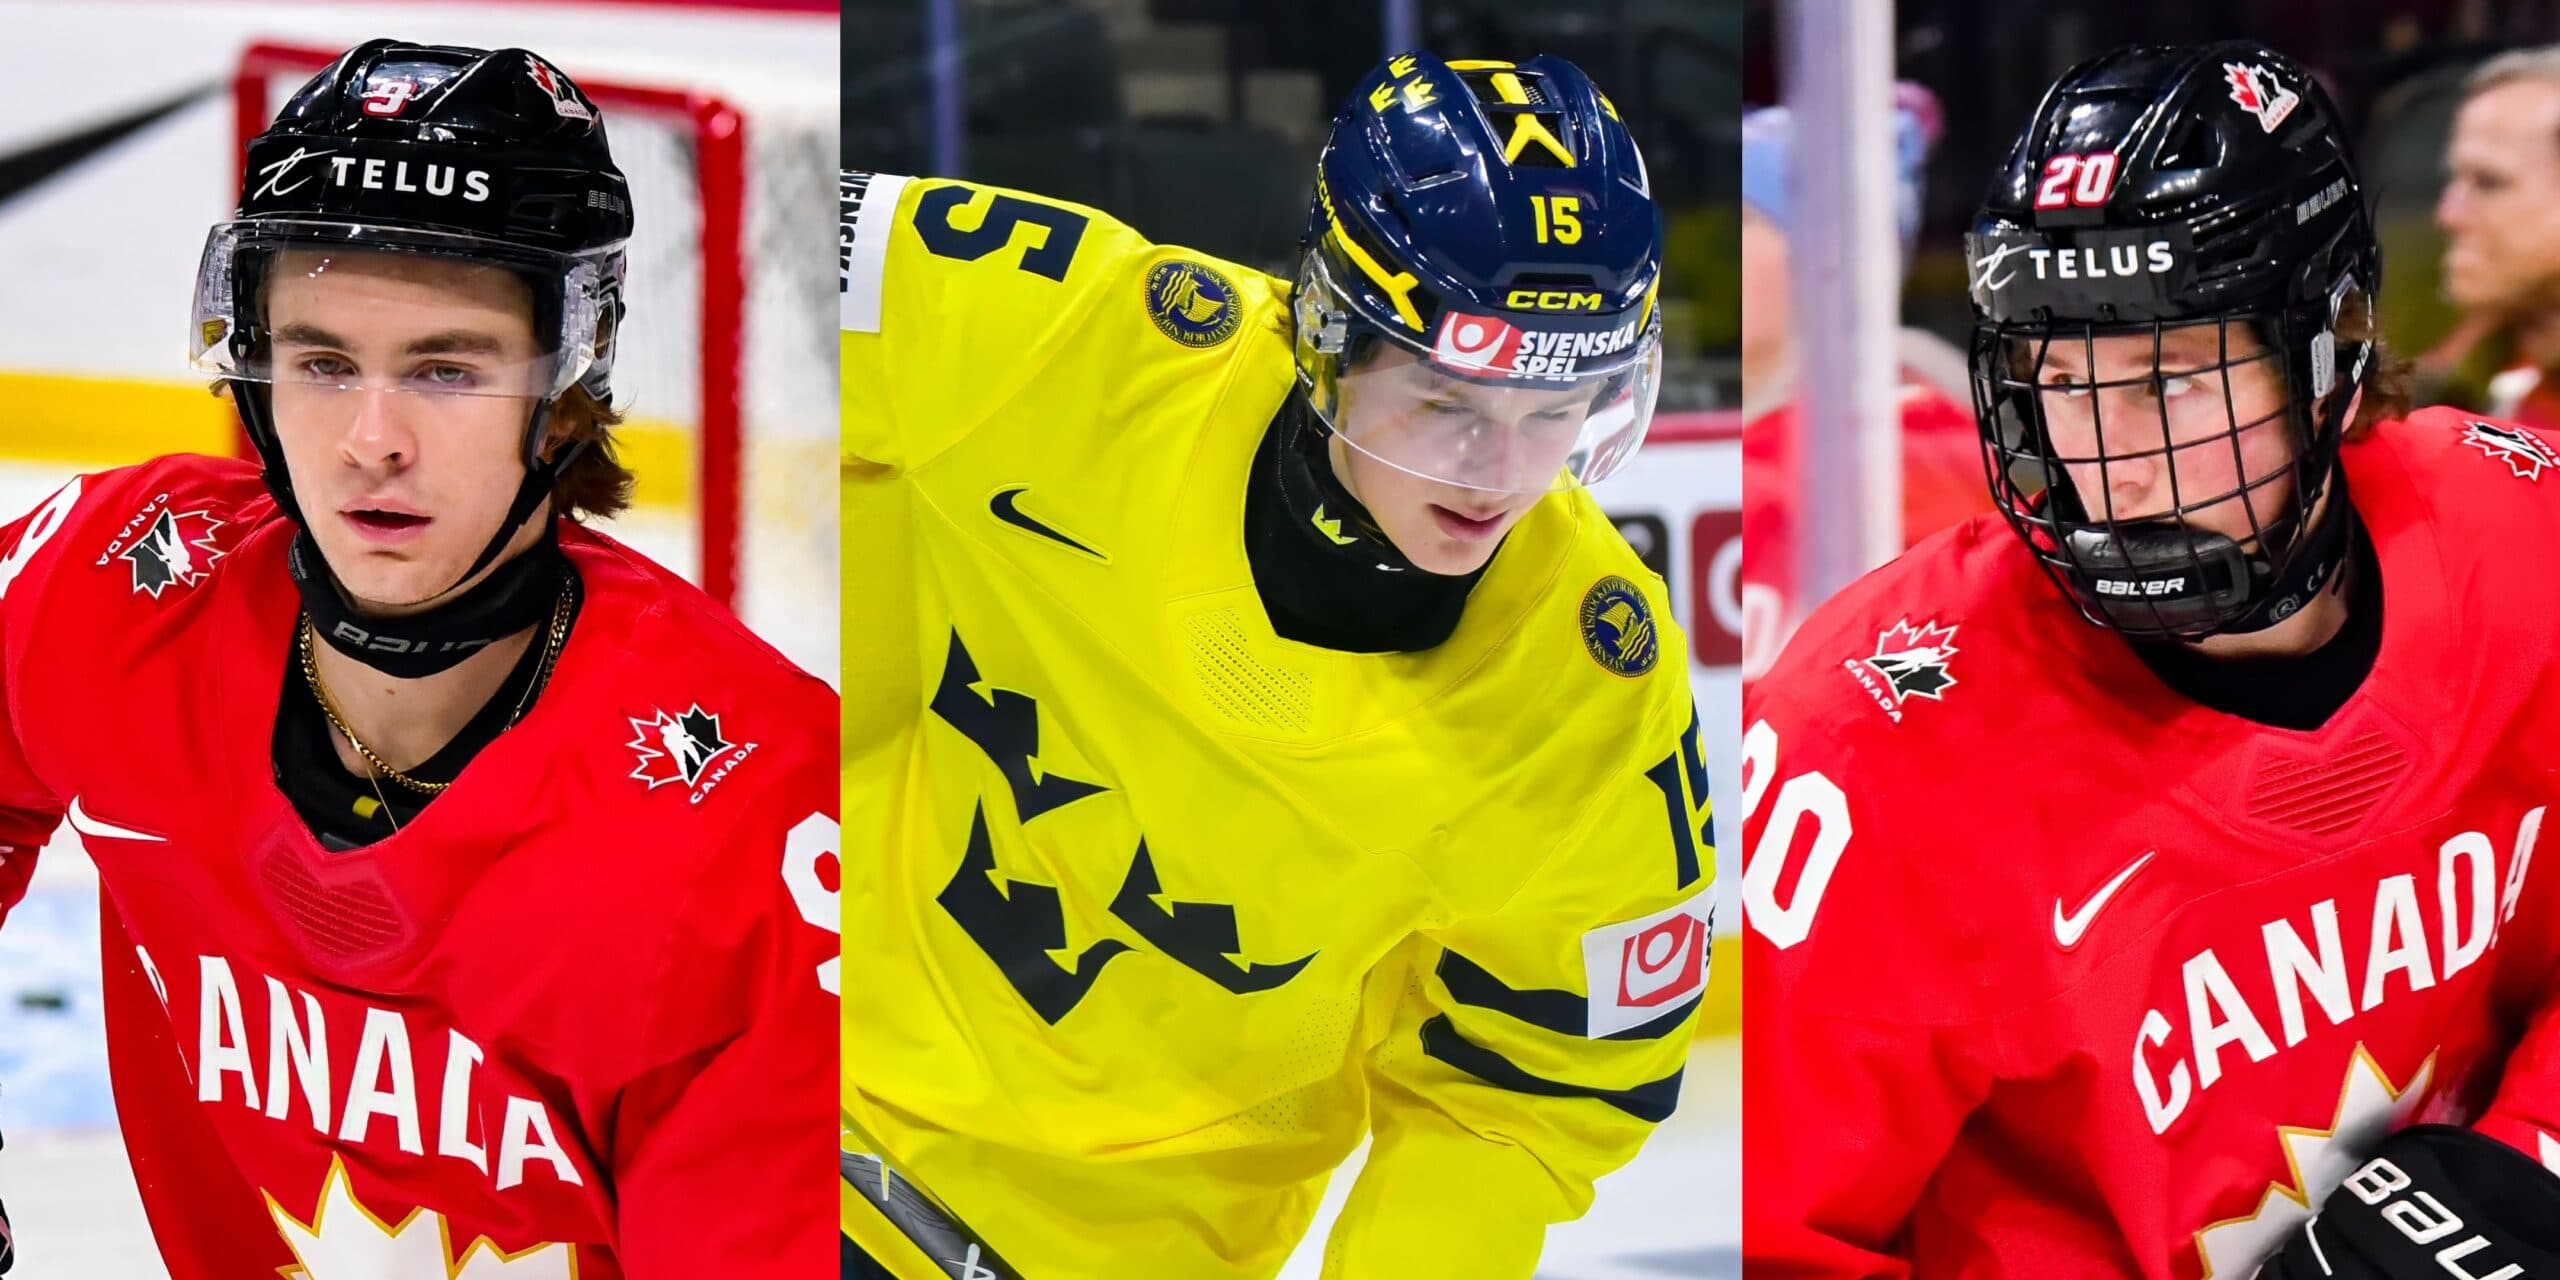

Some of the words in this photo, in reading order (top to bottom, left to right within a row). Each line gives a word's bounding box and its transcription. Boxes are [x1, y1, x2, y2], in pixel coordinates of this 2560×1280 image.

[364, 79, 416, 117] 9
[331, 157, 490, 202] TELUS
[2033, 151, 2118, 210] 20
[840, 168, 876, 293] VENS
[912, 185, 1090, 283] 5
[1530, 195, 1582, 245] 15
[2029, 241, 2174, 280] TELUS
[1506, 290, 1602, 311] CCM
[1516, 320, 1635, 357] SVENSKA
[1507, 355, 1578, 382] SPEL
[96, 493, 168, 566] CANADA
[2096, 577, 2185, 596] BAUER
[1844, 659, 1903, 723] CANADA
[690, 742, 758, 804] CANADA
[2132, 805, 2548, 1136] CANADA
[136, 944, 584, 1192] ANADA
